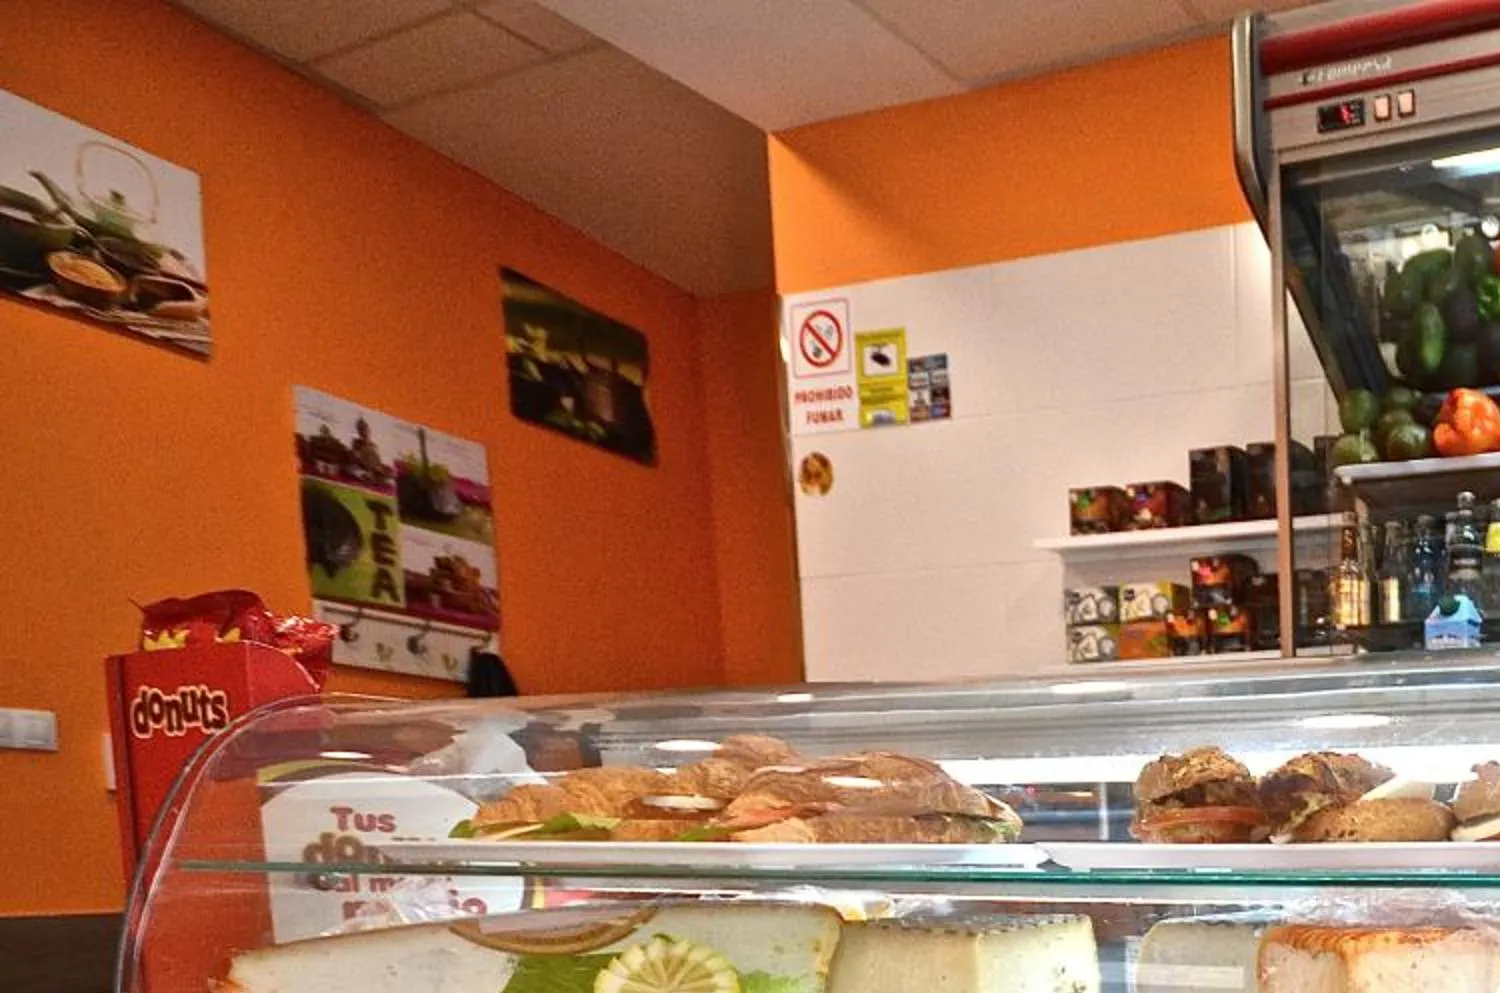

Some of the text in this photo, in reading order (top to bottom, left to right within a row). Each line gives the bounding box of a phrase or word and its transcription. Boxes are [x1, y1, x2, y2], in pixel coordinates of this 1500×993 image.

[795, 385, 853, 403] PROHIBIDO
[807, 409, 843, 424] FUMAR
[366, 500, 399, 602] TEA
[130, 685, 228, 738] donuts
[329, 806, 397, 832] Tus
